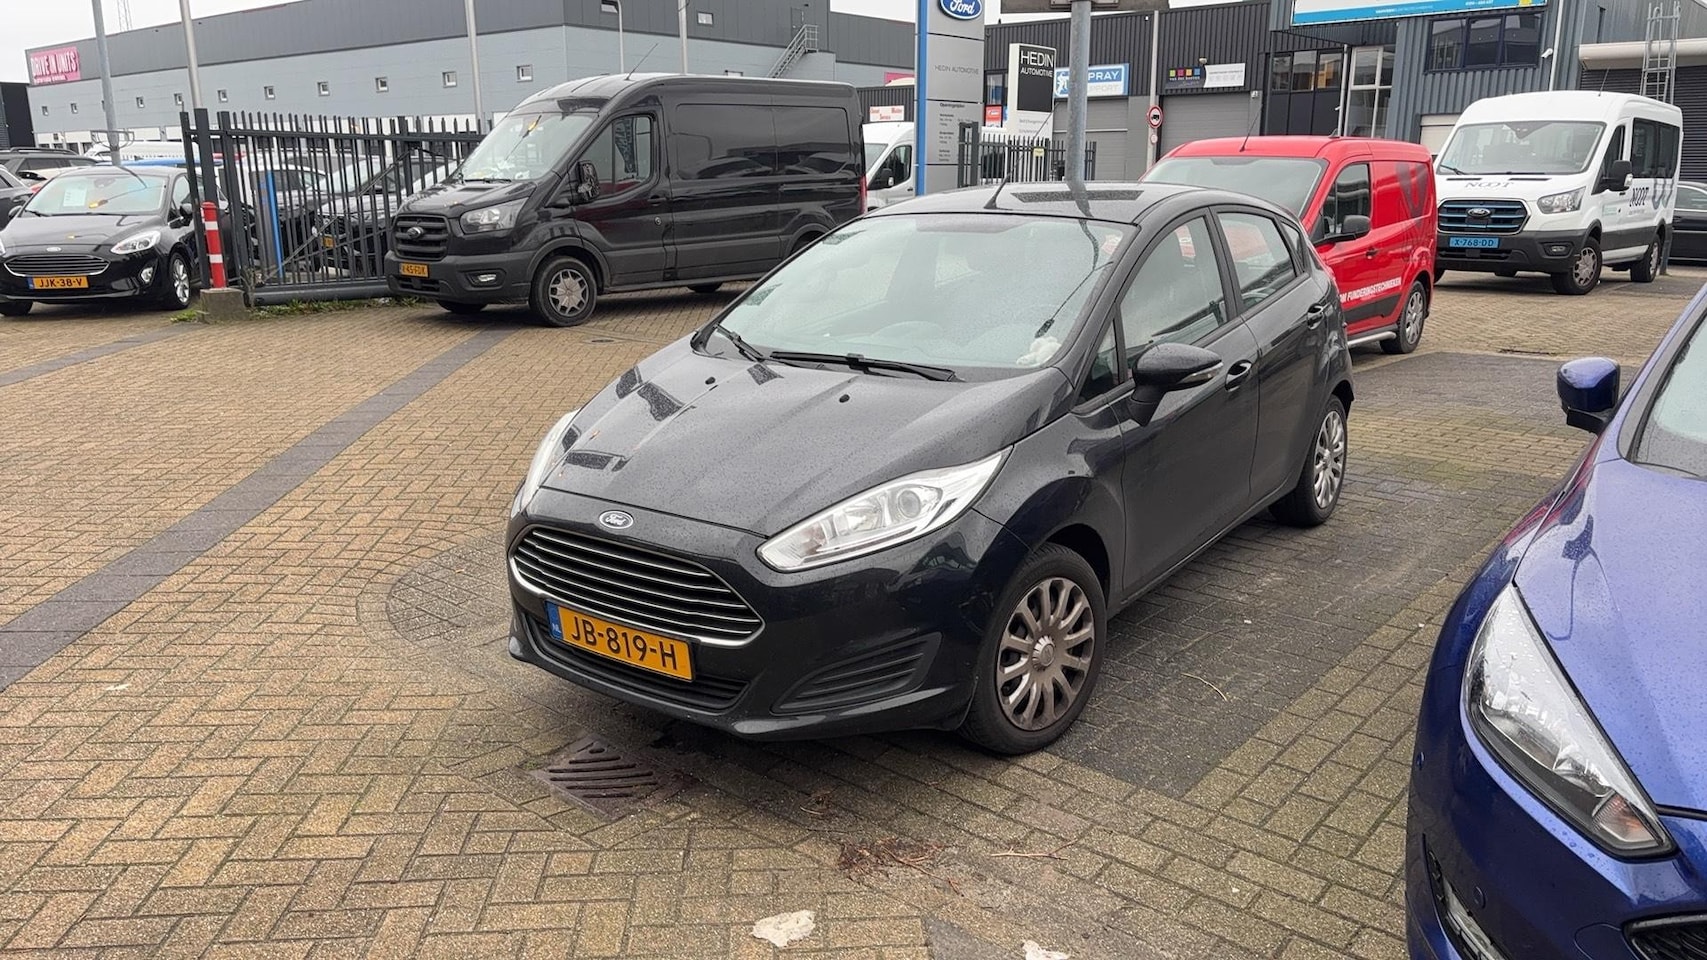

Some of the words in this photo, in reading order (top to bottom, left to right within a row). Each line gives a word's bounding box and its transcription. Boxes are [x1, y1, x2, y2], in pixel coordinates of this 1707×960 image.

[950, 0, 975, 15] Ford
[31, 55, 51, 77] DRIVE
[50, 54, 58, 75] IN
[58, 51, 78, 73] UNITS
[1020, 50, 1054, 67] HEDIN
[935, 64, 951, 72] HEDIN
[952, 66, 979, 75] AUTOMOTIVE
[1020, 67, 1053, 77] AUTOMOTIVE
[1088, 70, 1119, 81] PRAY
[1090, 84, 1118, 94] PPORT
[1454, 239, 1494, 247] X-768-DD
[40, 278, 82, 288] JJK-38-V
[605, 513, 627, 526] Ford
[571, 616, 678, 671] JB-819-H
